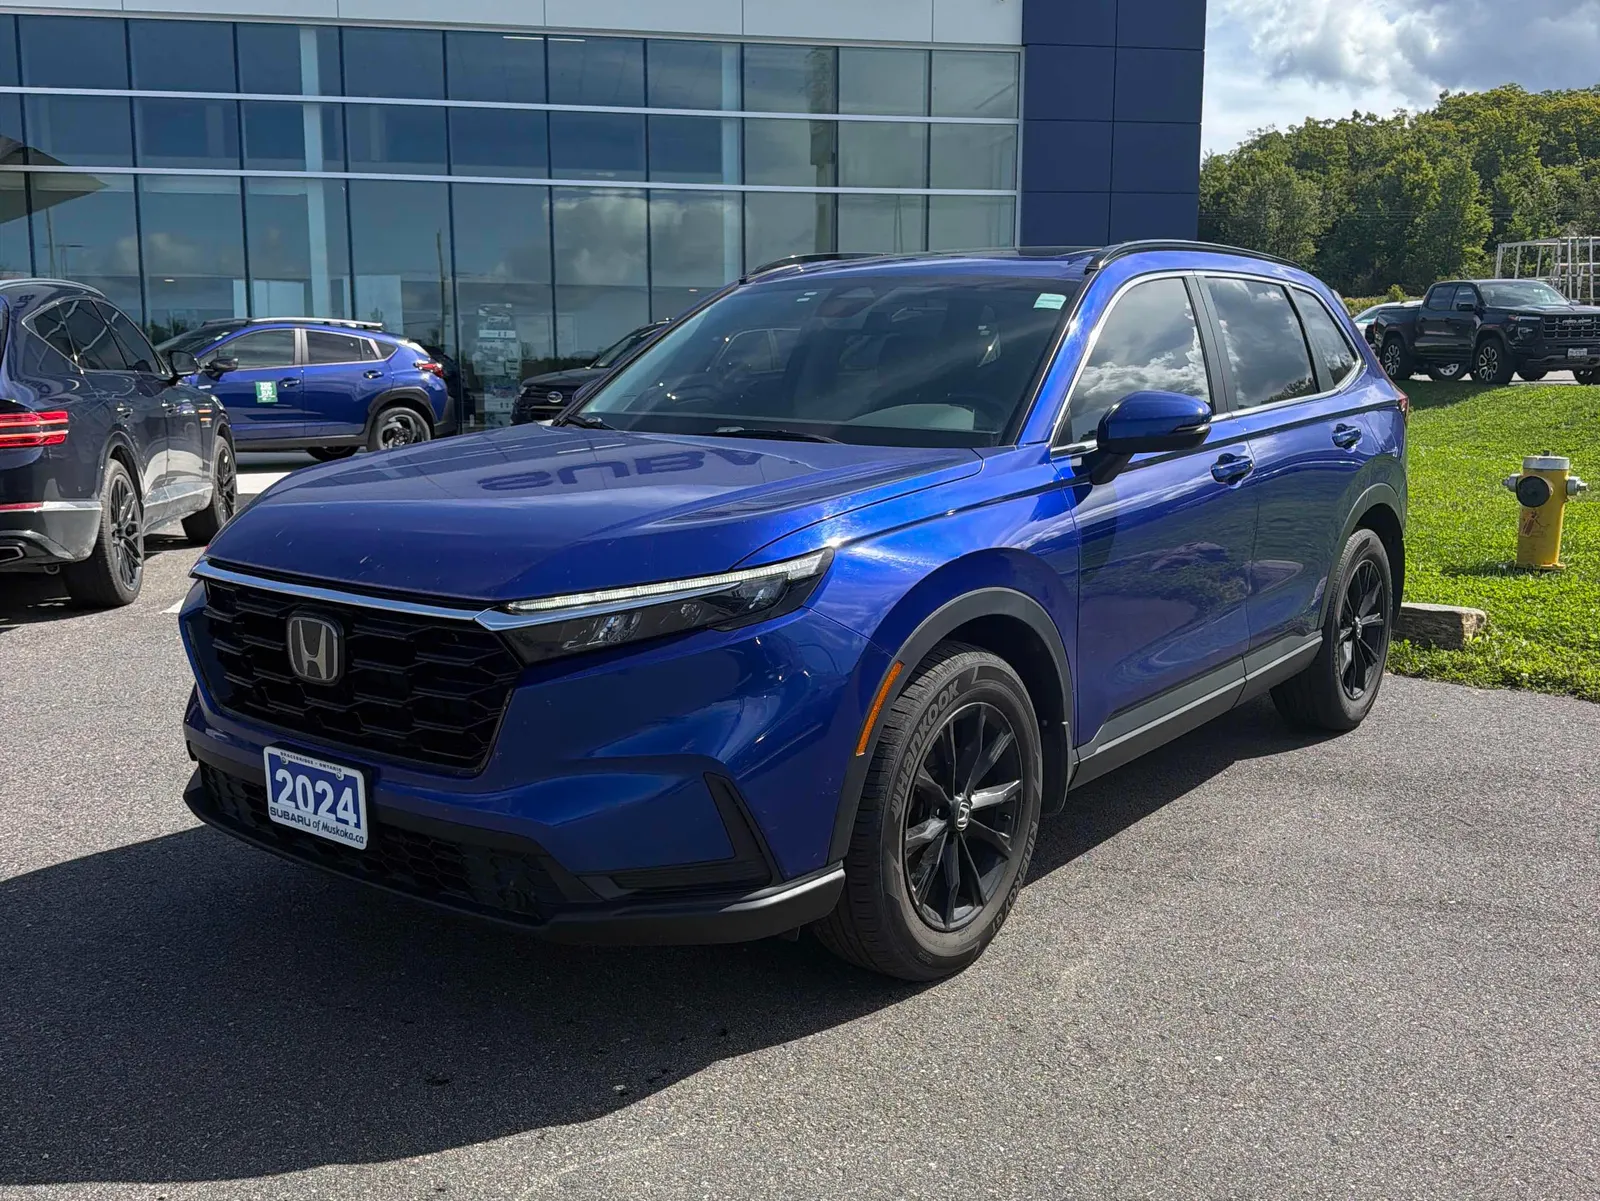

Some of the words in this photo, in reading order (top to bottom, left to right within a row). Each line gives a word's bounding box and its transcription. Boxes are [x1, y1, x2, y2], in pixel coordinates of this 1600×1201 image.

[319, 762, 342, 773] ONTARIO
[275, 768, 357, 828] 2024
[269, 806, 311, 827] SUBARU
[312, 820, 321, 832] of
[322, 823, 364, 844] Muskoka.ca
